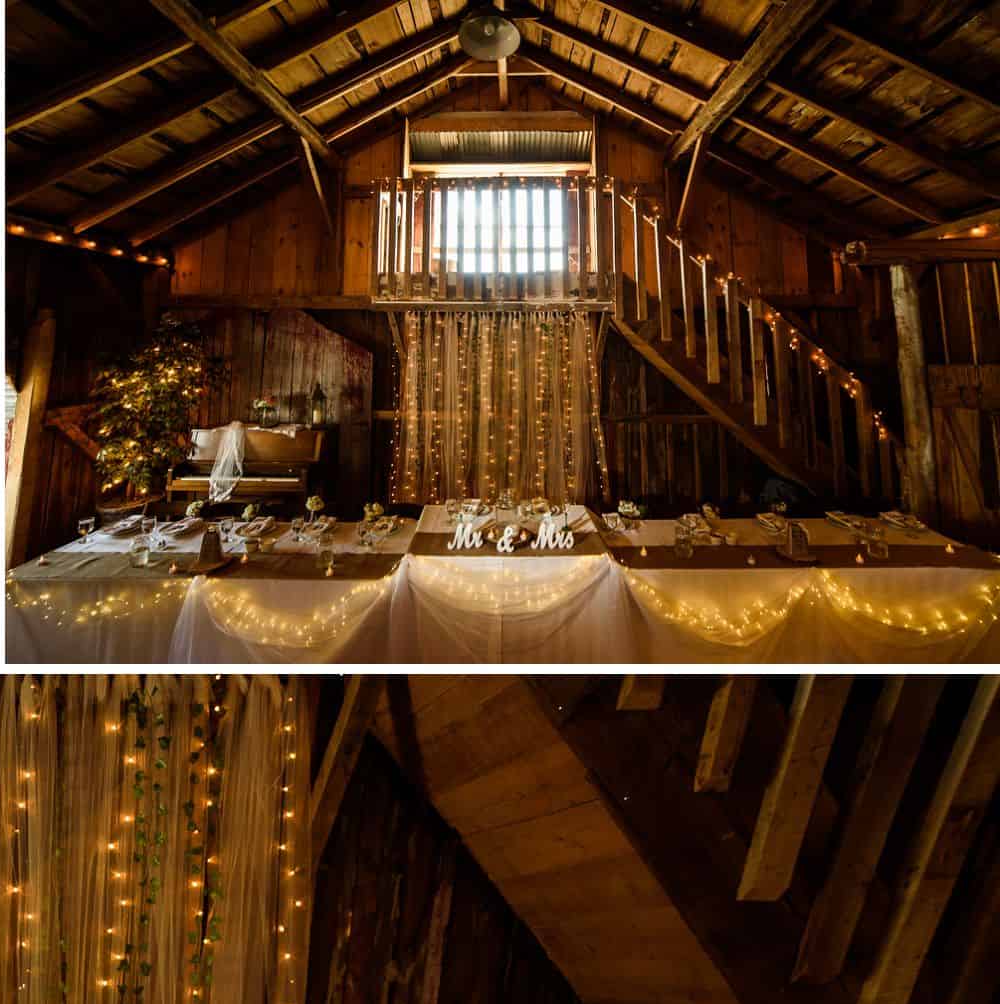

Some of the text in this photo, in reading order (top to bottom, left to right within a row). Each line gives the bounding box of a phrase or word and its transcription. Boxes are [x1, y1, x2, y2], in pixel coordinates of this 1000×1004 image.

[448, 522, 575, 553] Mr & Mrs
